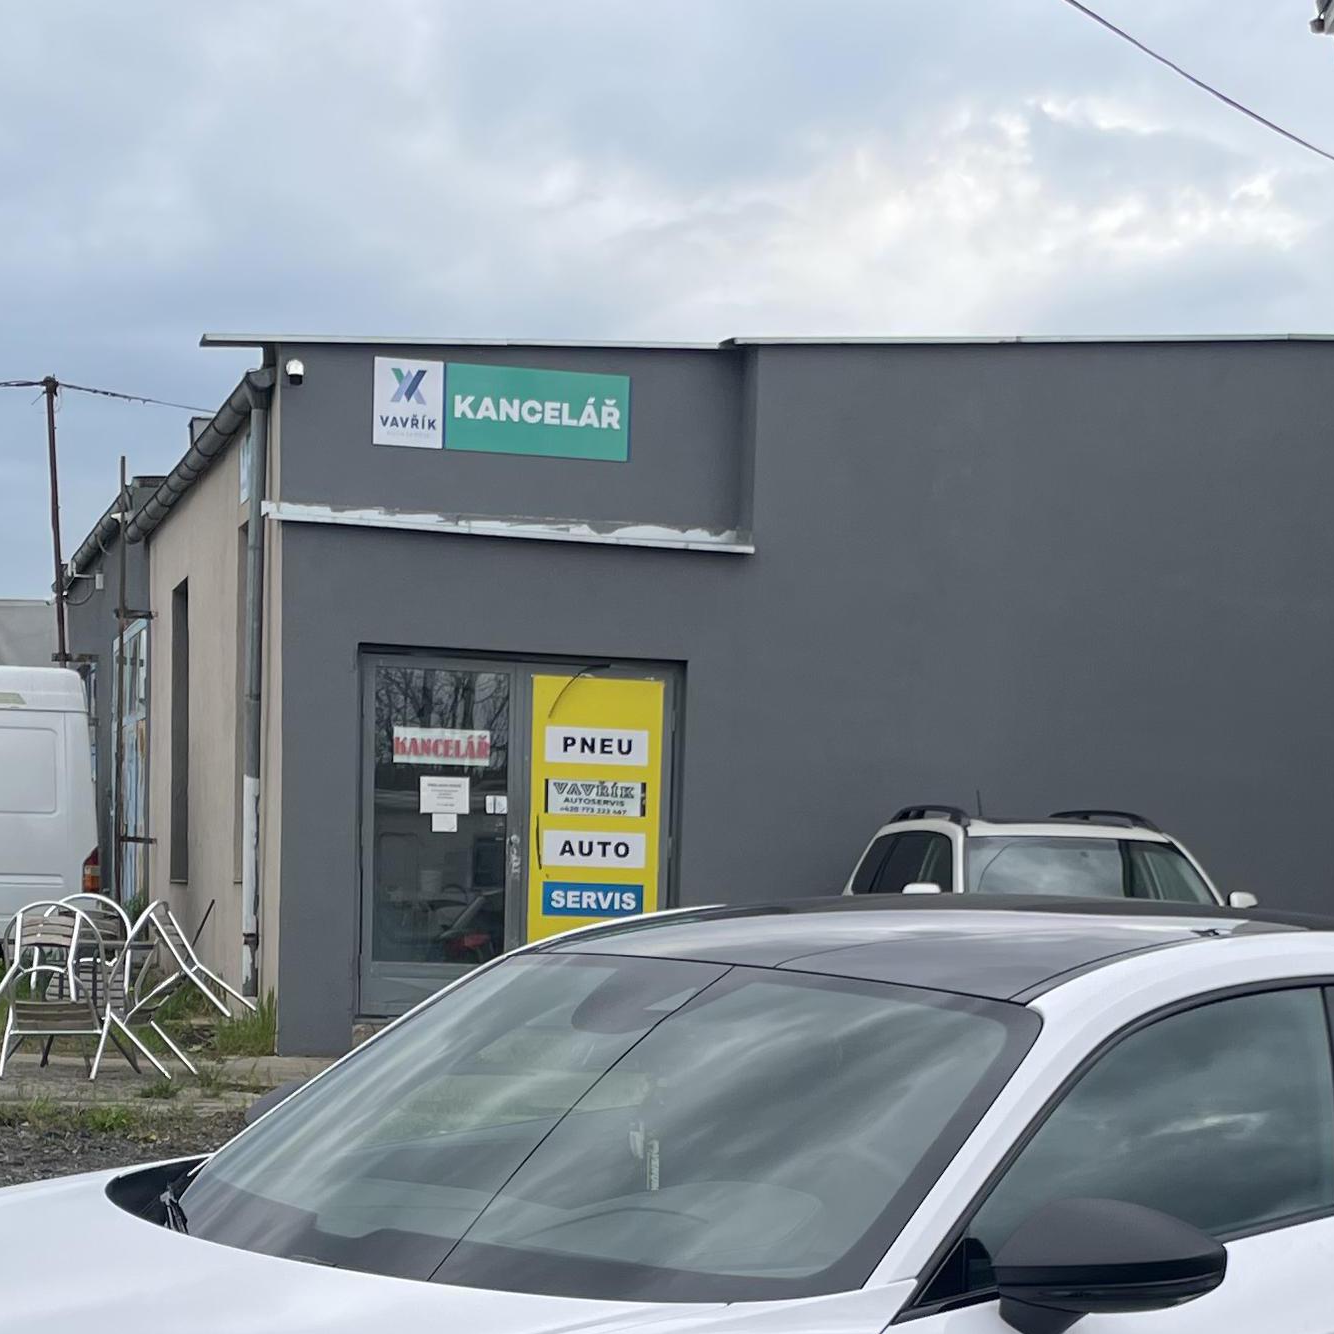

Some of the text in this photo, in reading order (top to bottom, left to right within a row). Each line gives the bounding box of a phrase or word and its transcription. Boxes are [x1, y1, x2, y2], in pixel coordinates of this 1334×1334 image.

[379, 413, 436, 431] VAVŘÍK
[453, 394, 621, 430] KANCELÁŘ
[394, 735, 490, 759] KANCELÁŘ
[563, 736, 633, 756] PNEU
[553, 781, 635, 799] VAVŘÍK
[559, 840, 630, 858] AUTO
[550, 890, 637, 911] SERVIS
